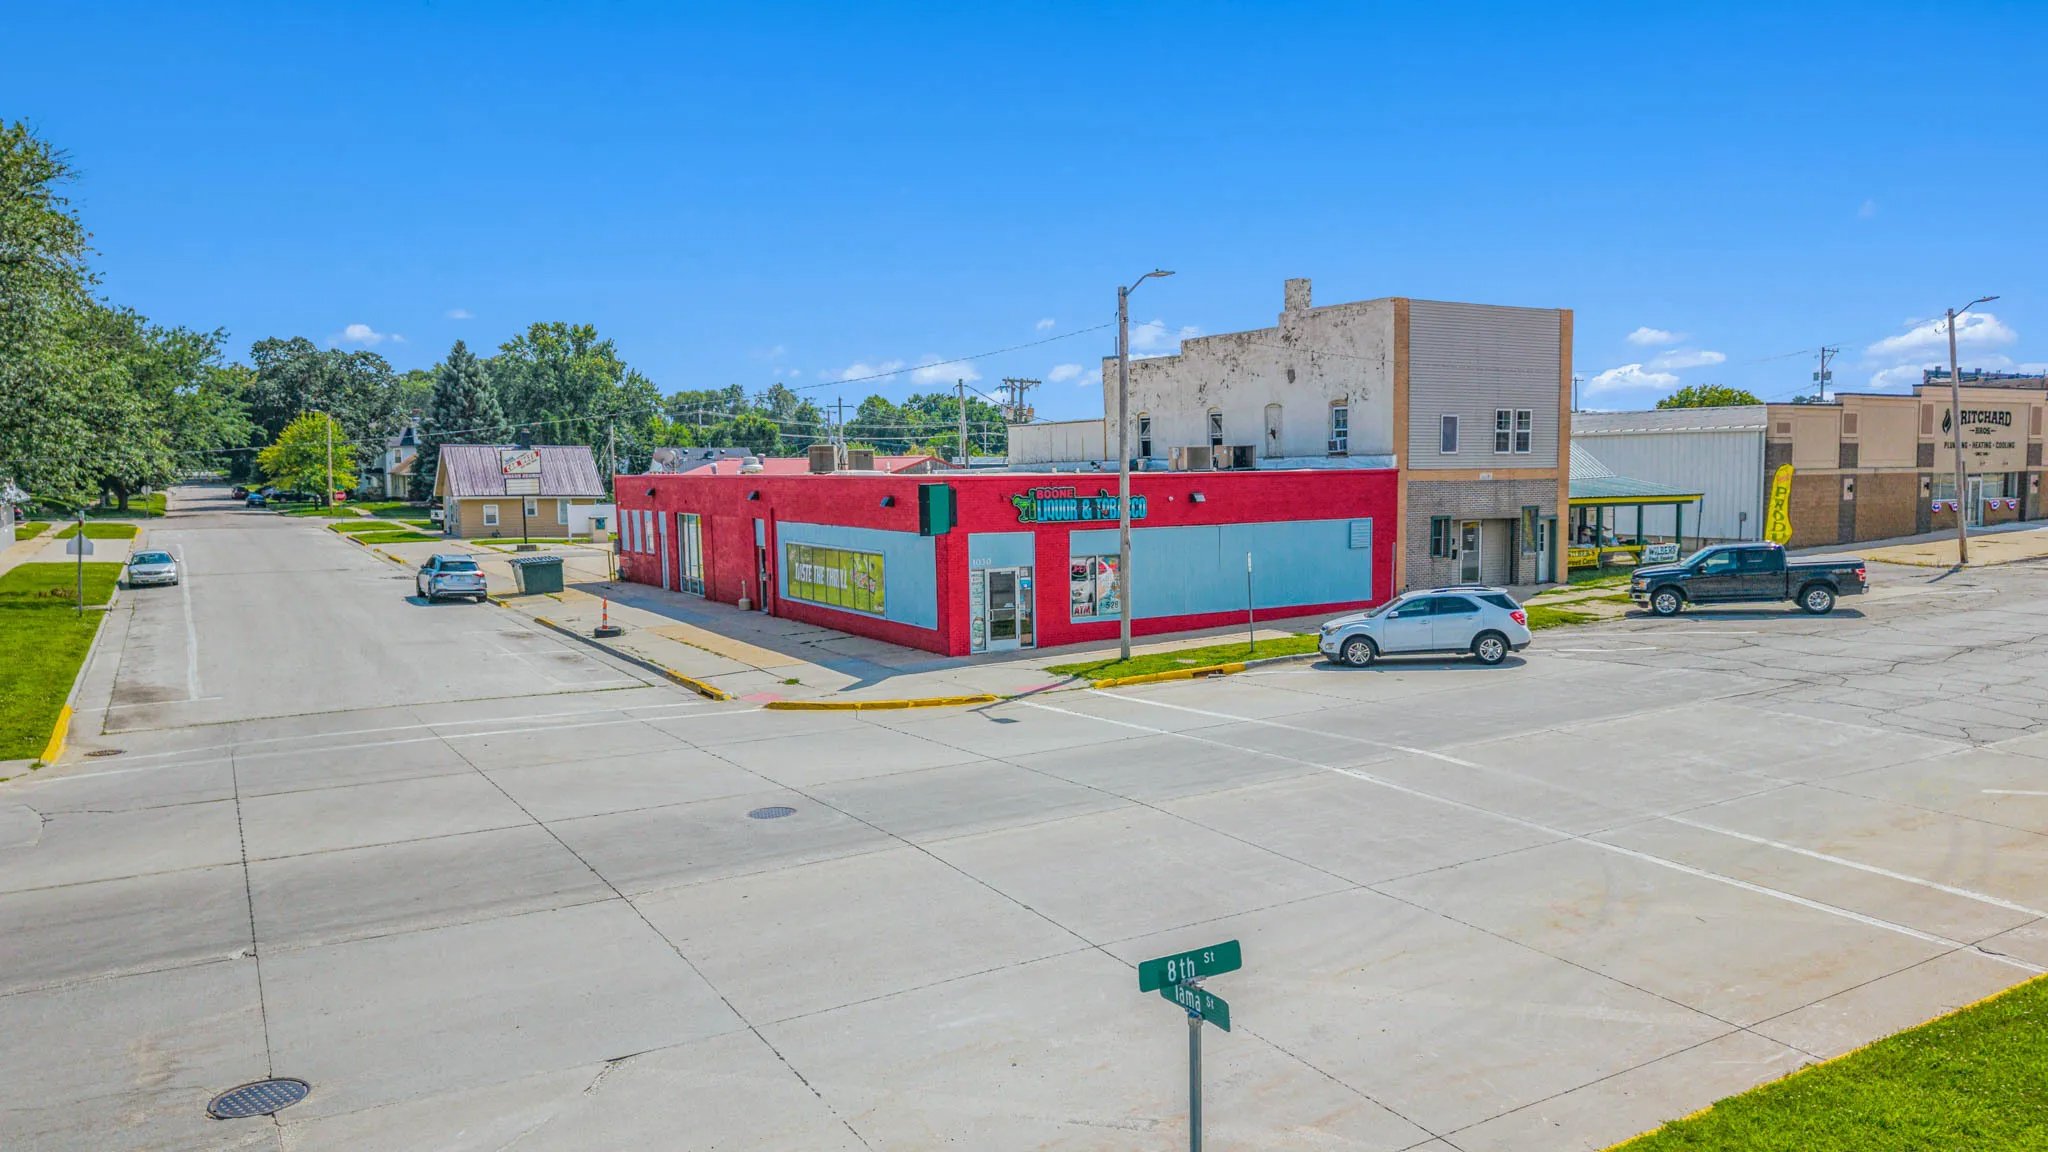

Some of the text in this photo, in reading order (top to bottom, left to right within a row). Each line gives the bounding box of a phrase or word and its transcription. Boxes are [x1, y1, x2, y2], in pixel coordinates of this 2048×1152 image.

[1960, 409, 2012, 427] RITCHARD
[1944, 441, 2015, 449] PLUMNG HEATING COOLING
[1036, 489, 1074, 499] BOONE
[1037, 498, 1146, 521] LIQUOR & TOBCO
[1770, 486, 1787, 542] PRODU
[813, 565, 825, 585] THE
[1074, 604, 1093, 615] ATM
[1167, 951, 1215, 982] 8th St
[1205, 995, 1215, 1009] St
